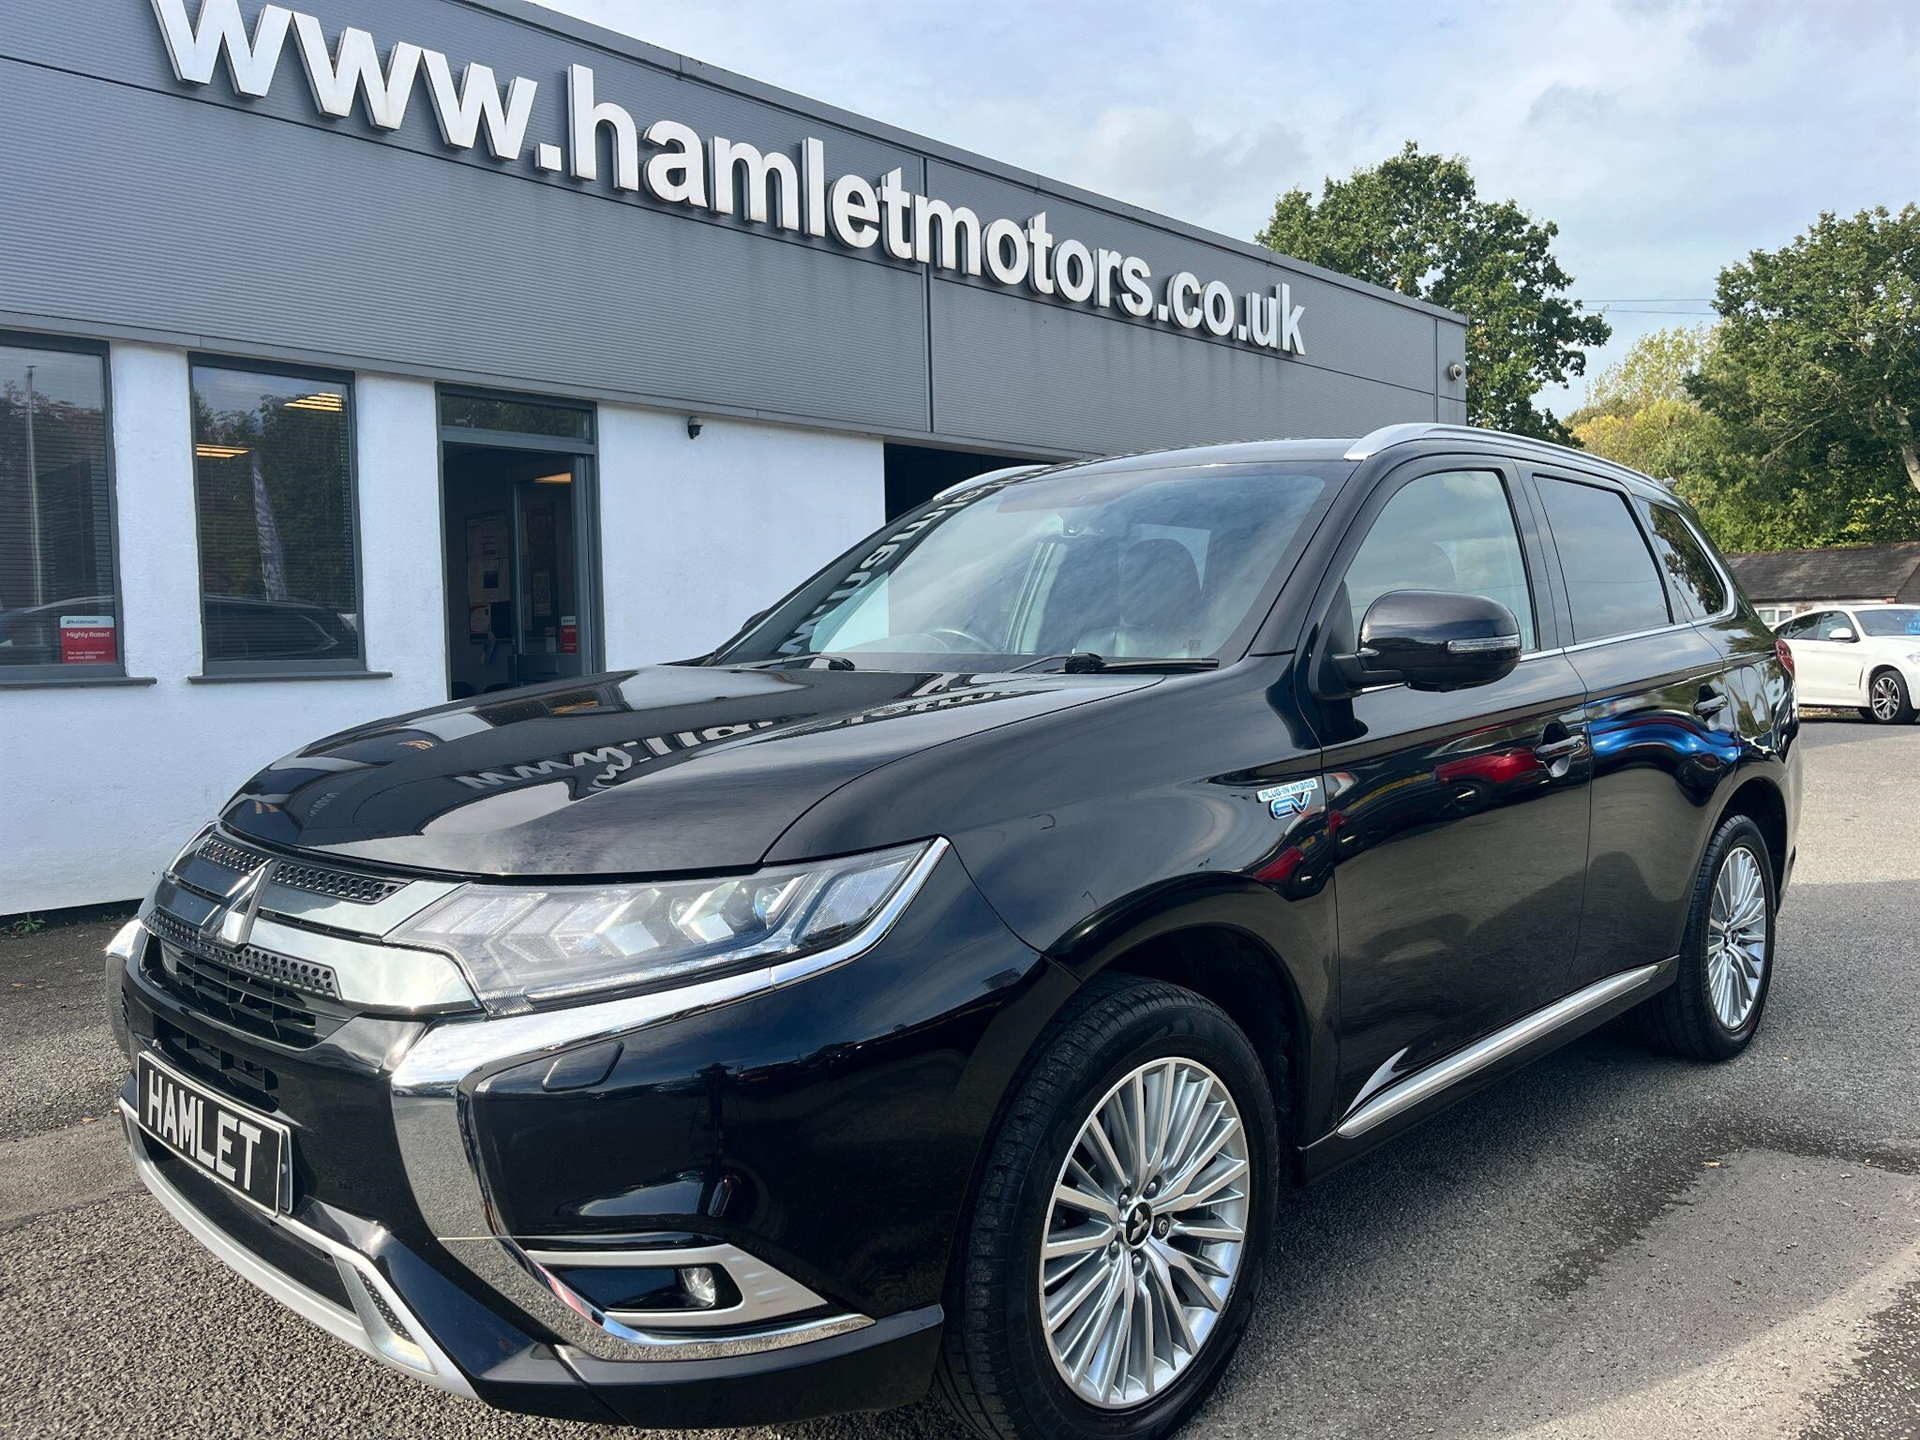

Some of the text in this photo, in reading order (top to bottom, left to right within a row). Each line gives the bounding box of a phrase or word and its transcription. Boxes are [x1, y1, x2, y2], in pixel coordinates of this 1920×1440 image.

[152, 0, 1306, 356] www.hamletmotors.co.uk
[66, 631, 88, 640] Highly
[1261, 780, 1316, 800] PLUG-IN HYBRID
[1270, 790, 1312, 820] EV
[147, 1069, 262, 1191] HAMLET
